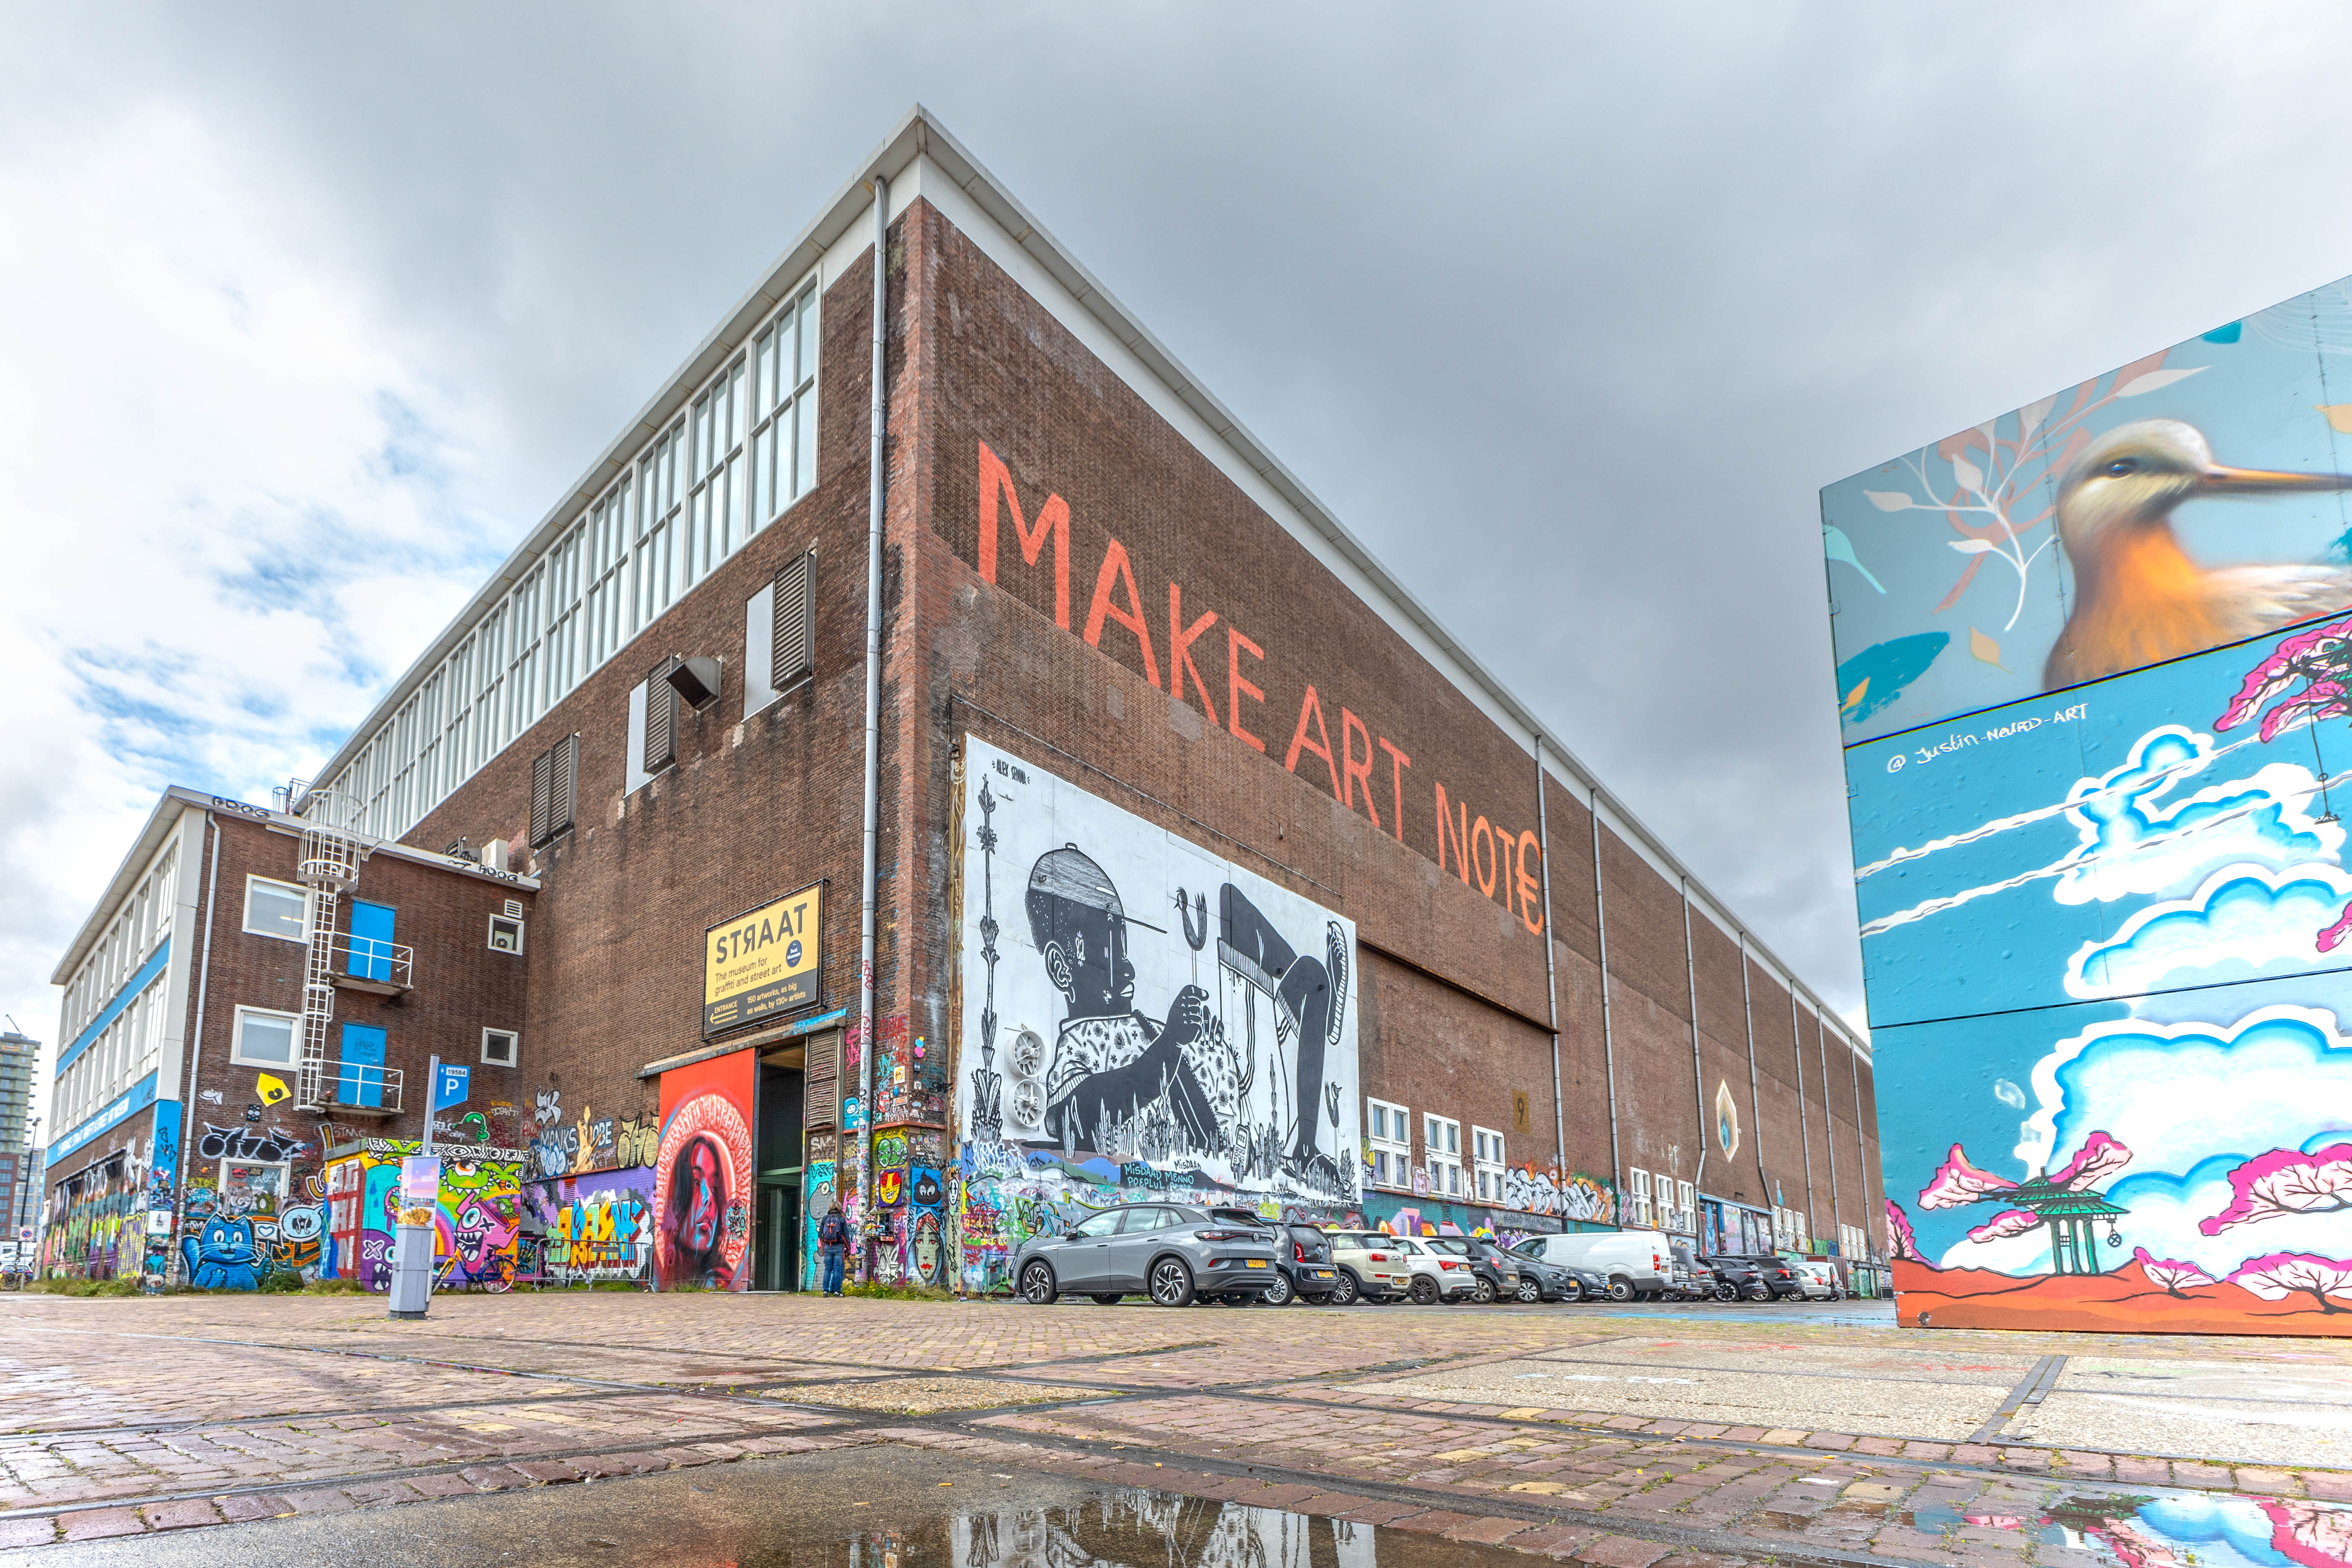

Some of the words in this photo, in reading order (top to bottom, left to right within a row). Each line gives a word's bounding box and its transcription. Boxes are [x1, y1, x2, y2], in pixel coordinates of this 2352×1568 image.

[979, 439, 1265, 753] MAKE
[1285, 684, 1410, 840] ART
[996, 758, 1009, 777] ALEX
[715, 971, 727, 983] The
[728, 960, 756, 978] museum
[758, 958, 768, 968] for
[715, 981, 735, 996] graffiti
[736, 973, 748, 987] and
[750, 970, 770, 983] street
[772, 964, 782, 975] art
[747, 995, 756, 1004] 150
[757, 988, 780, 1001] artworks,
[788, 982, 797, 991] big
[754, 1001, 768, 1013] walls,
[776, 996, 788, 1006] 130+
[789, 991, 806, 1002] artists
[715, 1001, 738, 1014] ENTRANCE
[445, 1078, 459, 1096] P
[1517, 1098, 1525, 1125] 9
